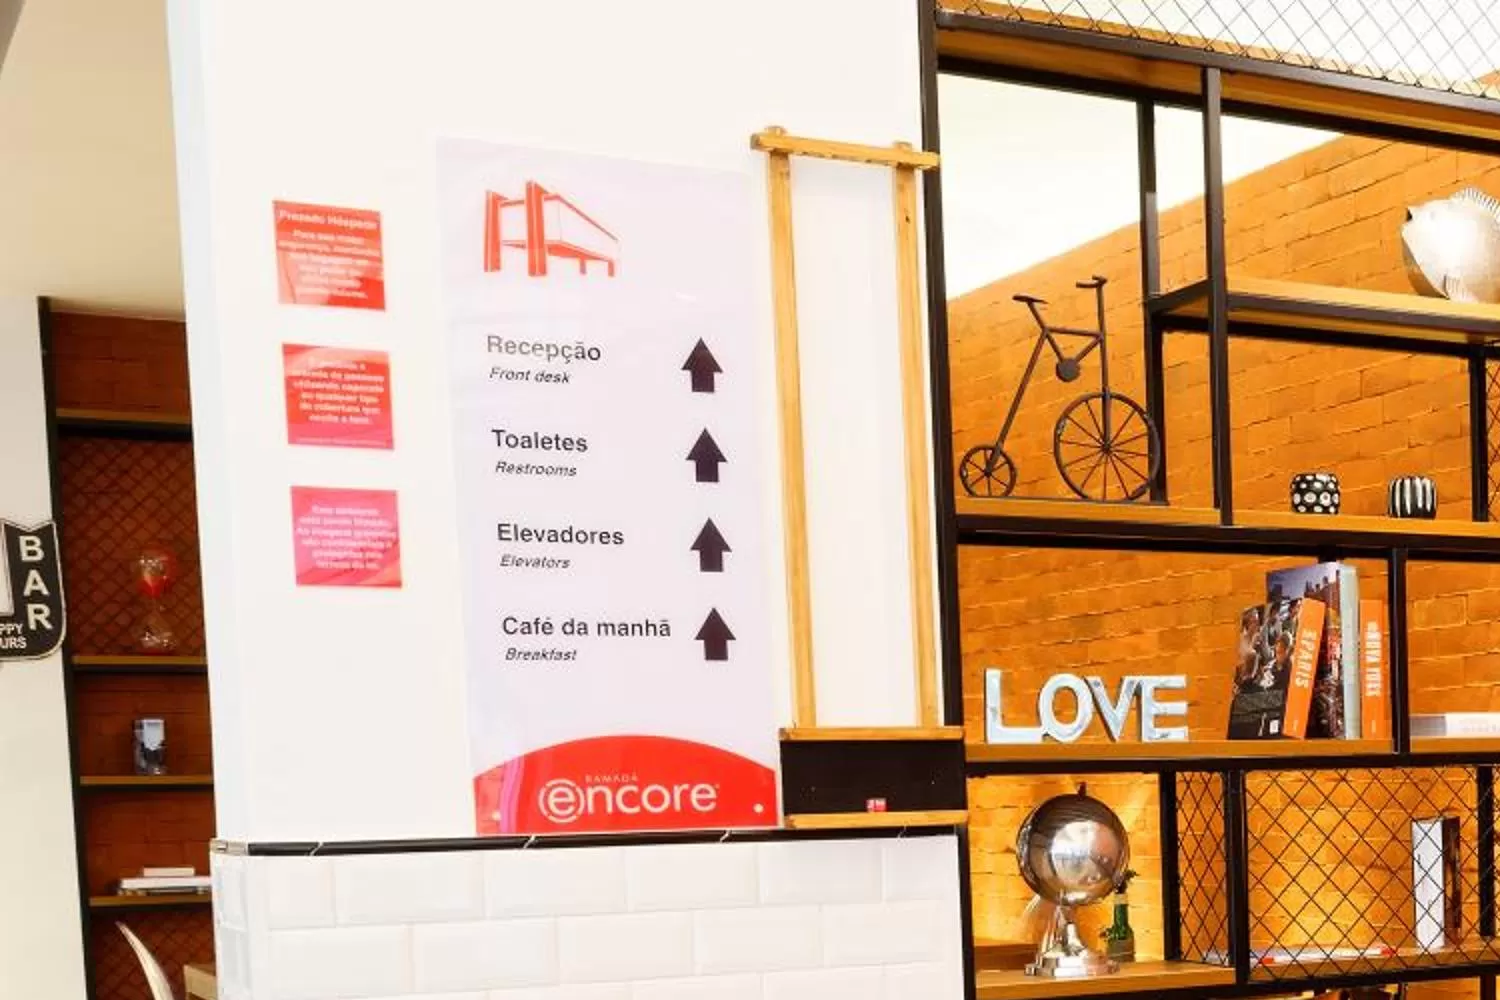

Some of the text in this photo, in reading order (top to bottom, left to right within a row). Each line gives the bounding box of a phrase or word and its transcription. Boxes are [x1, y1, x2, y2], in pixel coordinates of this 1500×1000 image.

[486, 335, 601, 364] Recepção
[489, 367, 570, 384] Front desk
[491, 429, 589, 452] Toaletes
[495, 461, 577, 477] Restrooms
[497, 523, 625, 545] Elevadores
[499, 554, 571, 570] Elevators
[19, 535, 53, 631] BAR
[502, 616, 671, 637] Café da manhã
[505, 648, 578, 662] Breakfast
[1295, 639, 1317, 689] PARIS
[985, 668, 1188, 744] LOVE
[542, 781, 717, 817] encore
